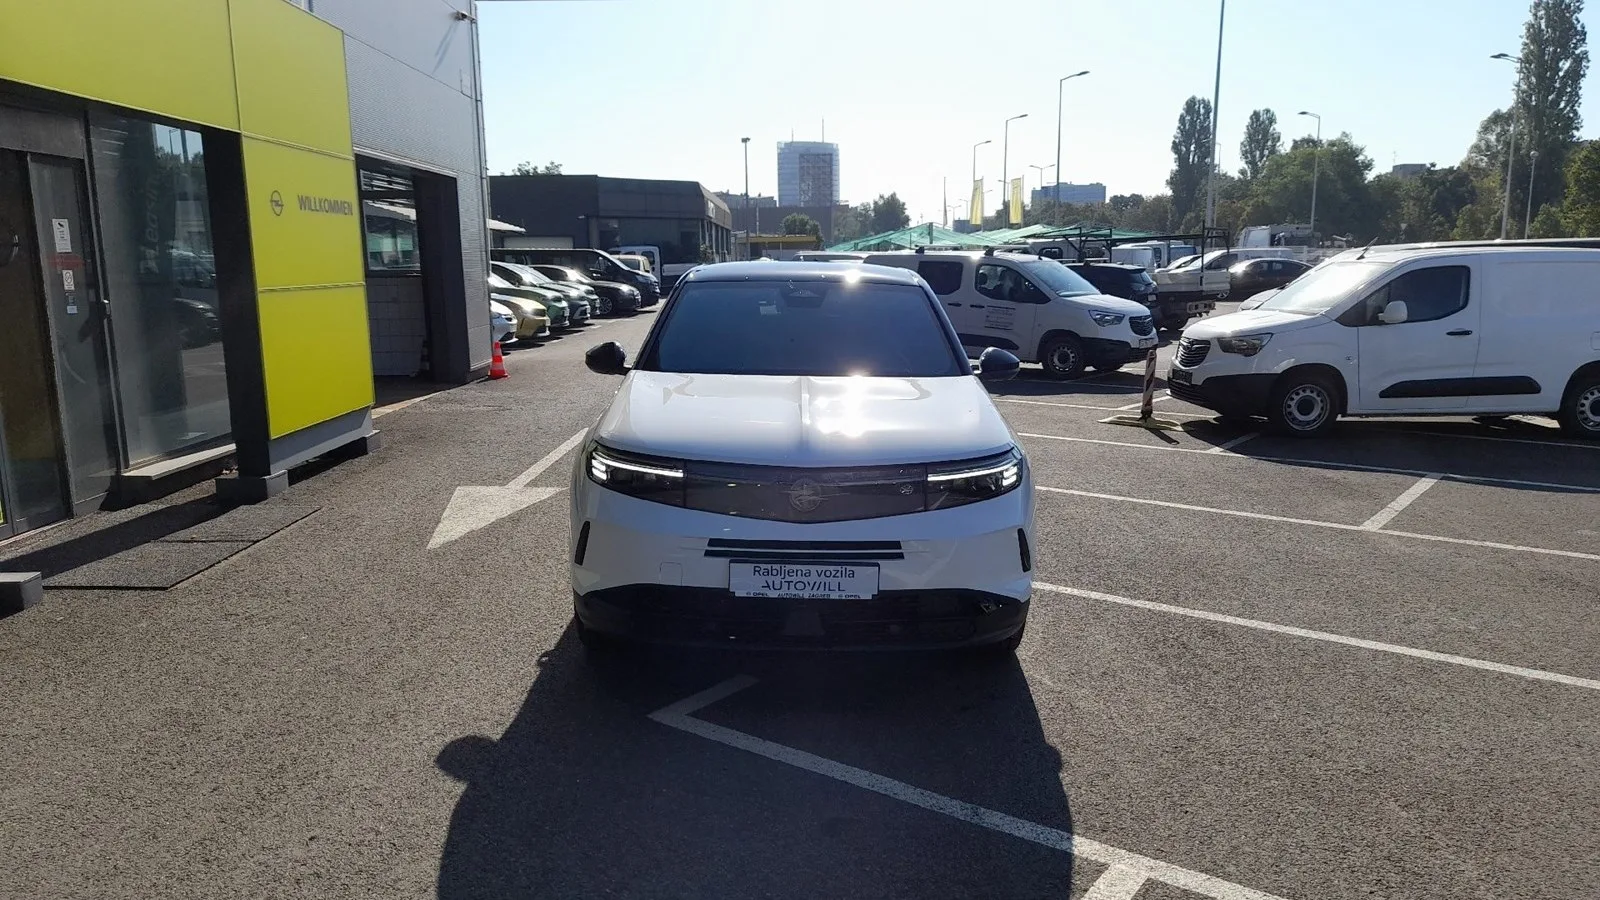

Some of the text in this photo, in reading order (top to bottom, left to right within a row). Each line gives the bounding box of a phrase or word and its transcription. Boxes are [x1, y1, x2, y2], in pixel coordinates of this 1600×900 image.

[297, 195, 354, 216] WILLKOMMEN
[753, 565, 855, 579] Rabljena vozila
[761, 580, 846, 592] AUTOWILL
